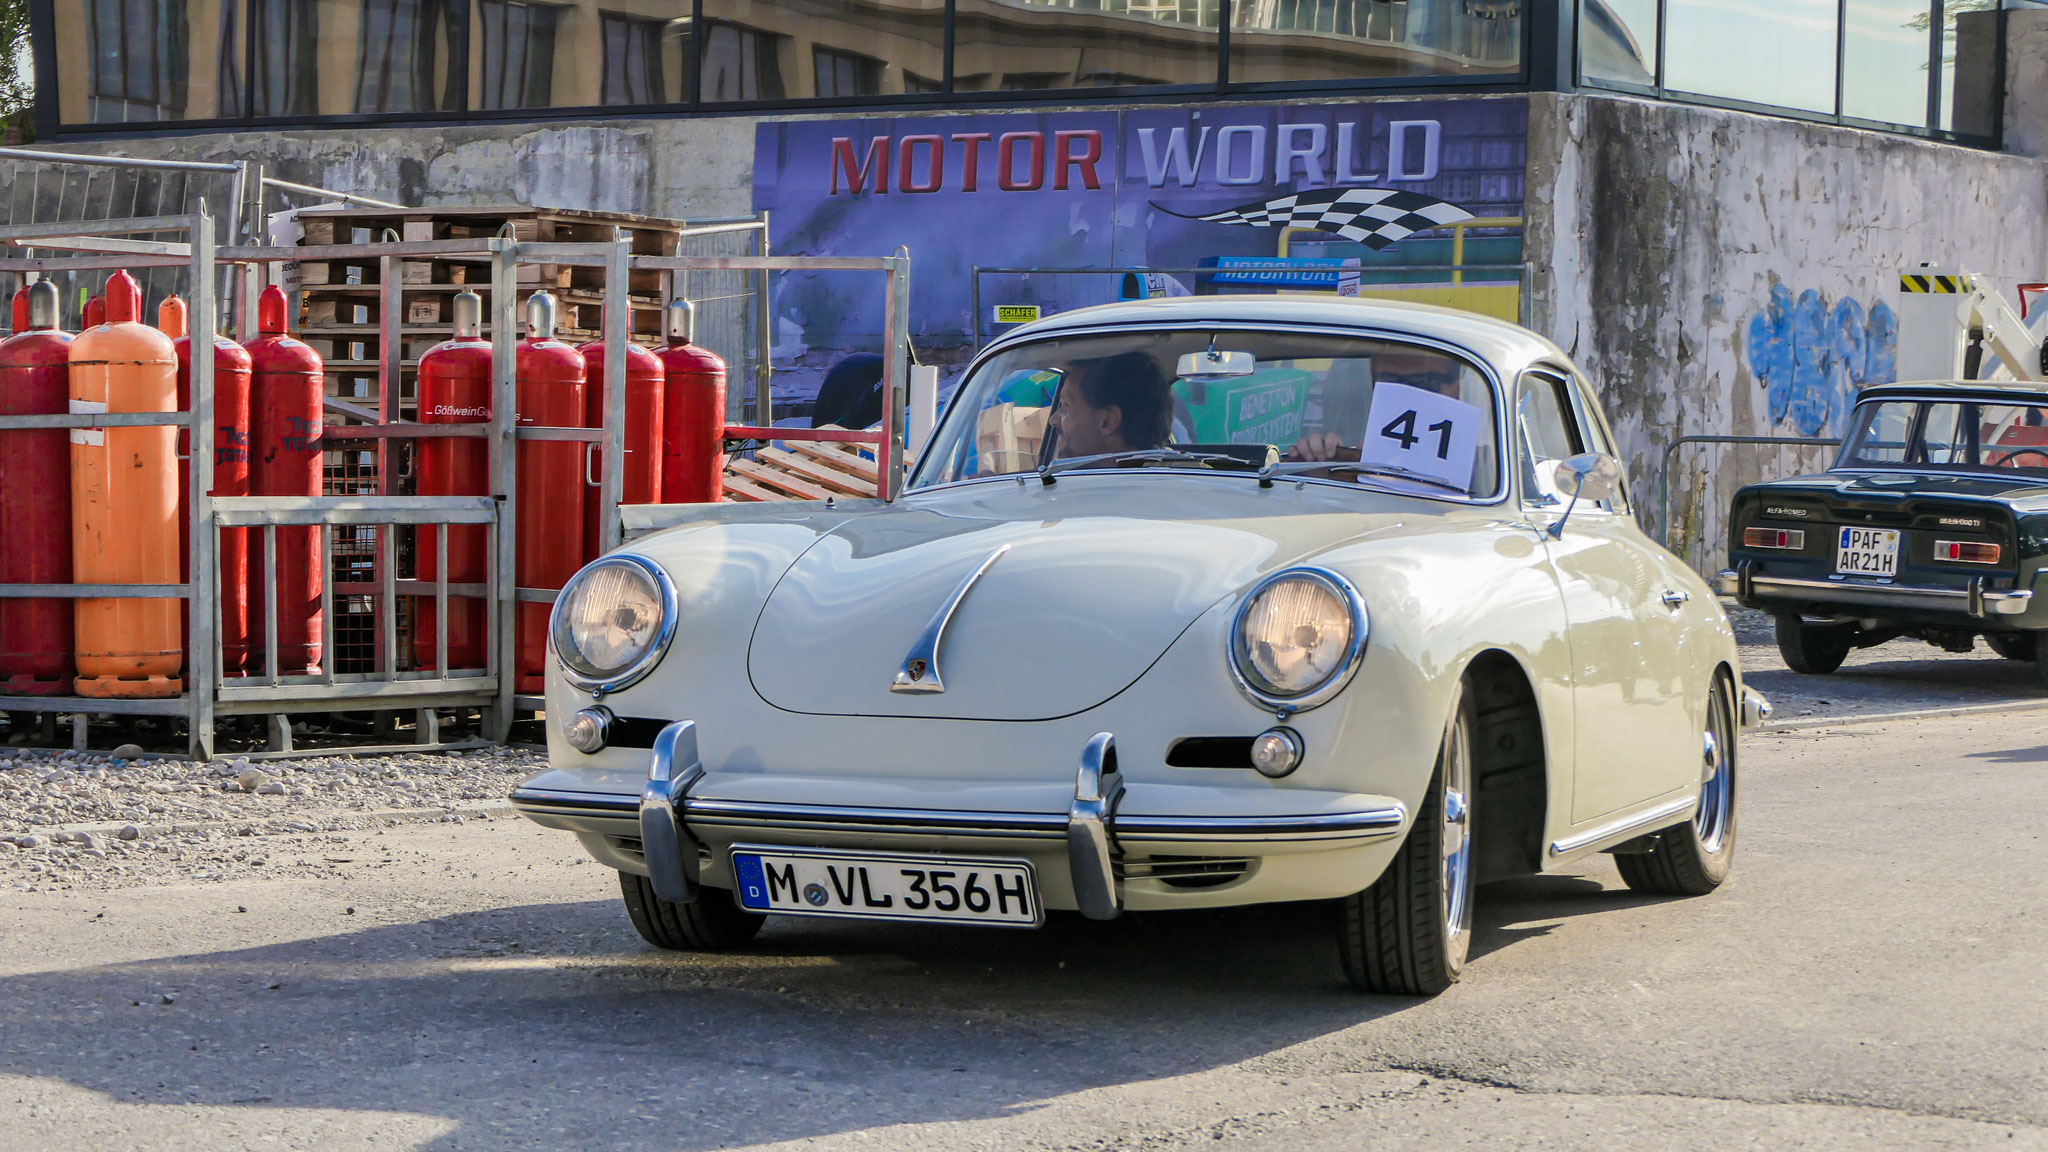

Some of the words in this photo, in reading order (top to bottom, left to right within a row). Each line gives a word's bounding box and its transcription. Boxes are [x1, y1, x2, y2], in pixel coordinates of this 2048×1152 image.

[829, 130, 1101, 195] MOTOR
[1137, 120, 1442, 189] WORLD
[434, 404, 492, 419] GößweinGa
[1239, 386, 1296, 422] BENETTON
[1380, 409, 1453, 461] 41
[1851, 530, 1882, 550] PAF
[1840, 551, 1859, 570] AR
[1862, 553, 1893, 573] 21H
[748, 885, 760, 898] D
[765, 861, 800, 903] M
[826, 864, 893, 908] VL
[900, 868, 1029, 916] 356H
